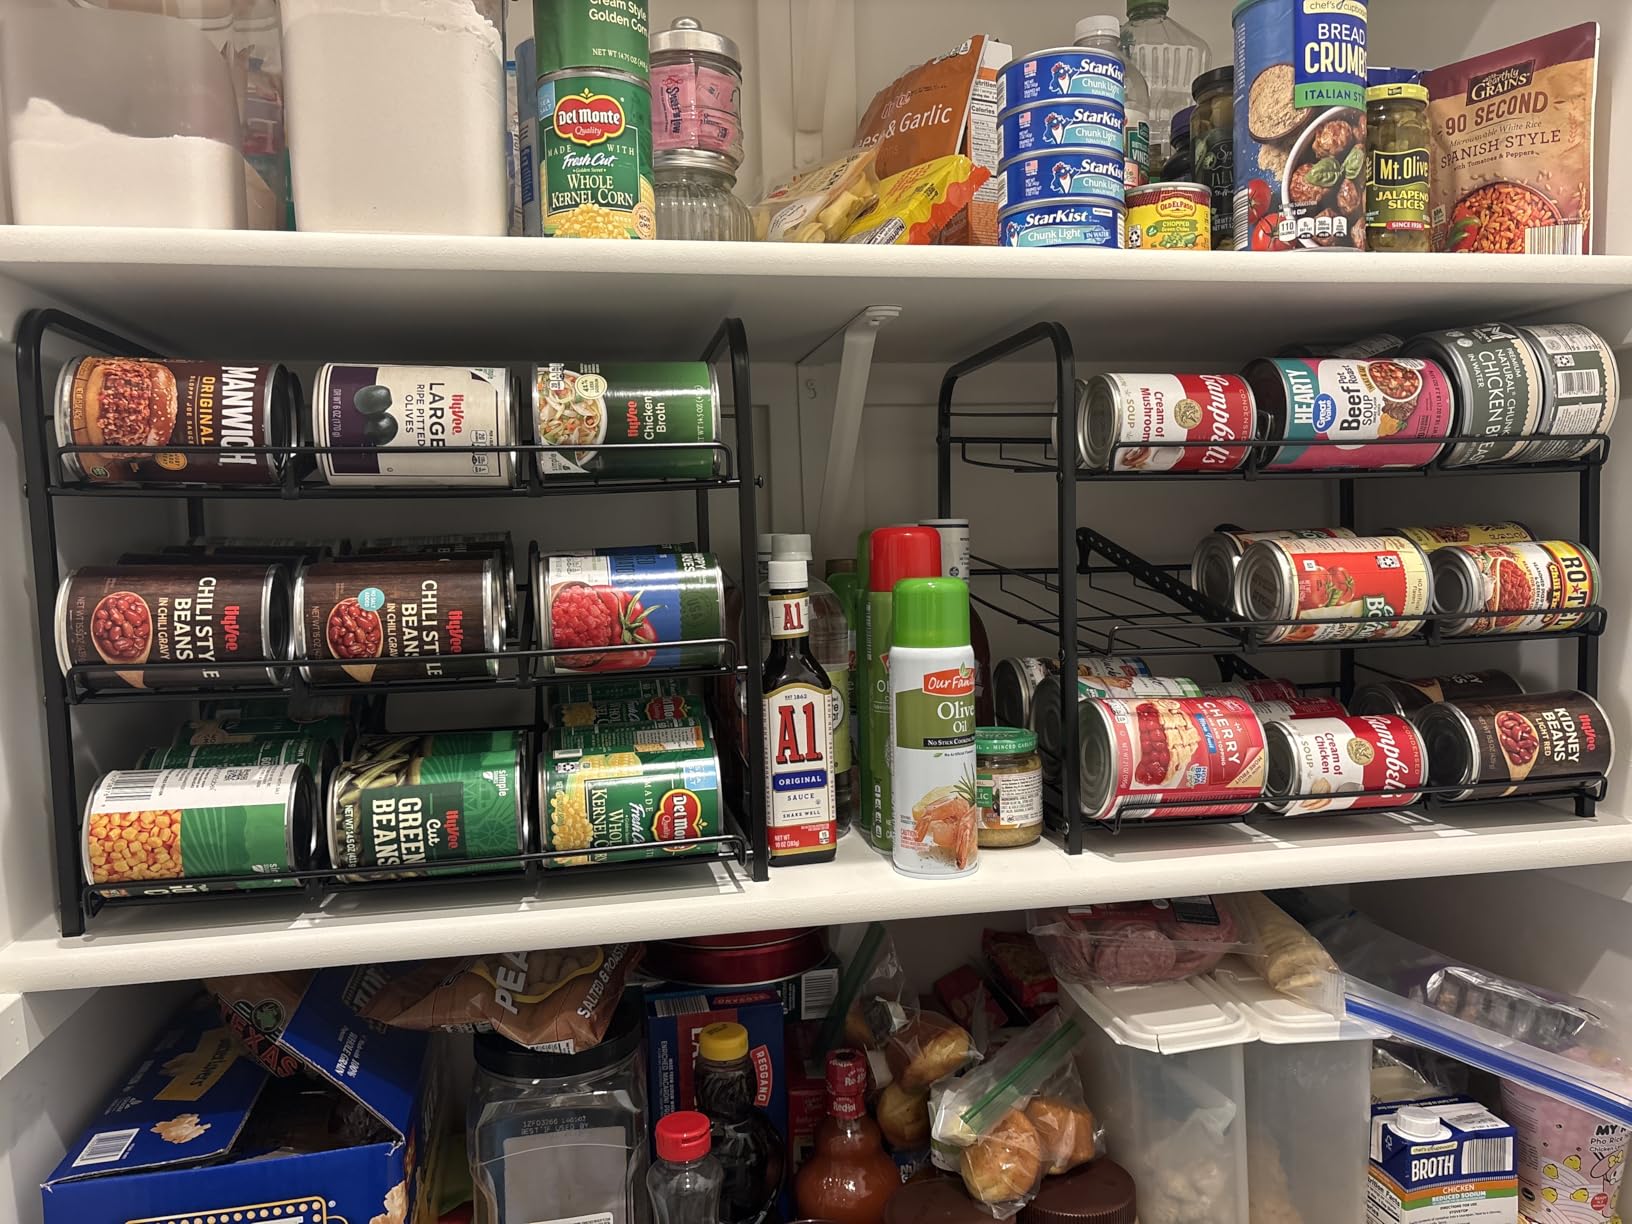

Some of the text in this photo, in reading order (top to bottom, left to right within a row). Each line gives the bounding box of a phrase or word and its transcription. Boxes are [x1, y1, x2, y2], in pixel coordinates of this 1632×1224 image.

[588, 8, 630, 28] Golden
[628, 1, 647, 21] Style
[1309, 1, 1336, 10] chef's
[1318, 23, 1366, 46] BREAD
[592, 48, 617, 58] NET WT
[1080, 59, 1124, 83] StarKist
[1082, 78, 1106, 90] Chunk
[1305, 89, 1351, 101] ITALIAN
[1471, 73, 1529, 101] GRAINS
[558, 109, 620, 125] Del Monte
[885, 121, 896, 139] &
[899, 104, 952, 133] Garlic
[971, 105, 995, 115] Calories
[1074, 109, 1123, 129] StarKist
[1445, 91, 1549, 136] 90 SECOND
[575, 126, 602, 136] Quality
[1076, 128, 1101, 140] Chunk
[1500, 122, 1523, 133] White
[1525, 120, 1542, 130] Rice
[548, 144, 635, 157] MADE WITH
[562, 152, 591, 169] Fresh
[1440, 129, 1561, 169] SPANISH STYLE
[1467, 150, 1535, 169] Tomatoes Peppers
[1080, 159, 1124, 179] StarKist
[1380, 155, 1429, 180] Mt. Olive
[567, 174, 614, 189] WHOLE
[1083, 178, 1107, 189] Chunk
[552, 189, 634, 208] KERNEL CORN
[1388, 200, 1425, 210] SLICES
[1025, 208, 1089, 227] StarKist
[1162, 220, 1190, 228] CHOPPED
[1281, 221, 1294, 231] 110
[1028, 229, 1081, 244] Chunk Light
[1342, 364, 1359, 384] Roast
[1468, 353, 1485, 389] IN WATER
[1506, 347, 1522, 378] PREMIUM
[186, 375, 197, 400] SLOPPY
[1337, 371, 1348, 384] Pot
[1478, 350, 1503, 422] CHICKEN
[1286, 368, 1316, 424] HEARTY
[1339, 386, 1362, 431] Beef
[199, 375, 216, 446] ORIGINAL
[220, 366, 260, 466] MANWICH
[405, 394, 414, 434] OLIVES
[416, 384, 426, 447] RIPE PITTED
[429, 382, 446, 447] LARGE
[643, 395, 655, 440] Chicken
[656, 402, 667, 433] Broth
[1126, 398, 1136, 429] SOUP
[1139, 387, 1154, 442] Mushroom
[1153, 390, 1165, 438] Cream of
[1316, 399, 1327, 429] Great
[1324, 398, 1332, 421] Value
[1362, 394, 1374, 426] SOUP
[196, 576, 217, 622] CHILI
[421, 579, 438, 627] CHILI
[157, 597, 170, 660] IN CHILI GRAVY
[174, 597, 194, 661] BEANS
[386, 602, 397, 636] IN CHILI
[928, 677, 951, 690] Our
[937, 701, 975, 720] Olive
[953, 720, 968, 734] Oil
[1203, 701, 1241, 765] CHERRY
[1535, 717, 1552, 757] LIGHT RED
[1541, 711, 1566, 762] BEANS
[1554, 707, 1580, 763] KIDNEY
[993, 741, 1033, 751] MINCED GARLIC
[1301, 740, 1314, 769] SOUP
[1314, 735, 1330, 774] Chicken
[1324, 732, 1343, 776] Cream of
[1402, 725, 1421, 775] CONDENSED
[498, 769, 507, 797] simple
[778, 774, 822, 786] ORIGINAL
[1200, 766, 1208, 784] NON
[1234, 770, 1251, 785] FRUIT
[672, 794, 687, 818] Del
[787, 793, 815, 801] SAUCE
[344, 804, 354, 829] NET WT
[591, 788, 608, 838] KERNEL
[628, 802, 646, 834] Fresh
[372, 798, 401, 867] BEANS
[398, 797, 426, 865] GREEN
[426, 818, 441, 847] Cut
[661, 814, 671, 839] Quality
[577, 970, 610, 1019] SALTED &
[220, 1002, 299, 1078] TEXAS
[342, 1031, 358, 1056] WHOLE
[661, 1040, 669, 1103] ENRICHED MACARONI
[756, 1051, 768, 1103] REGGANO
[1590, 1137, 1607, 1146] Pho
[1596, 1124, 1618, 1136] MY
[1411, 1155, 1455, 1182] BROTH
[1385, 1190, 1400, 1207] Facts
[1432, 1191, 1486, 1202] REDUCED SODIUM
[1442, 1184, 1475, 1194] CHICKEN
